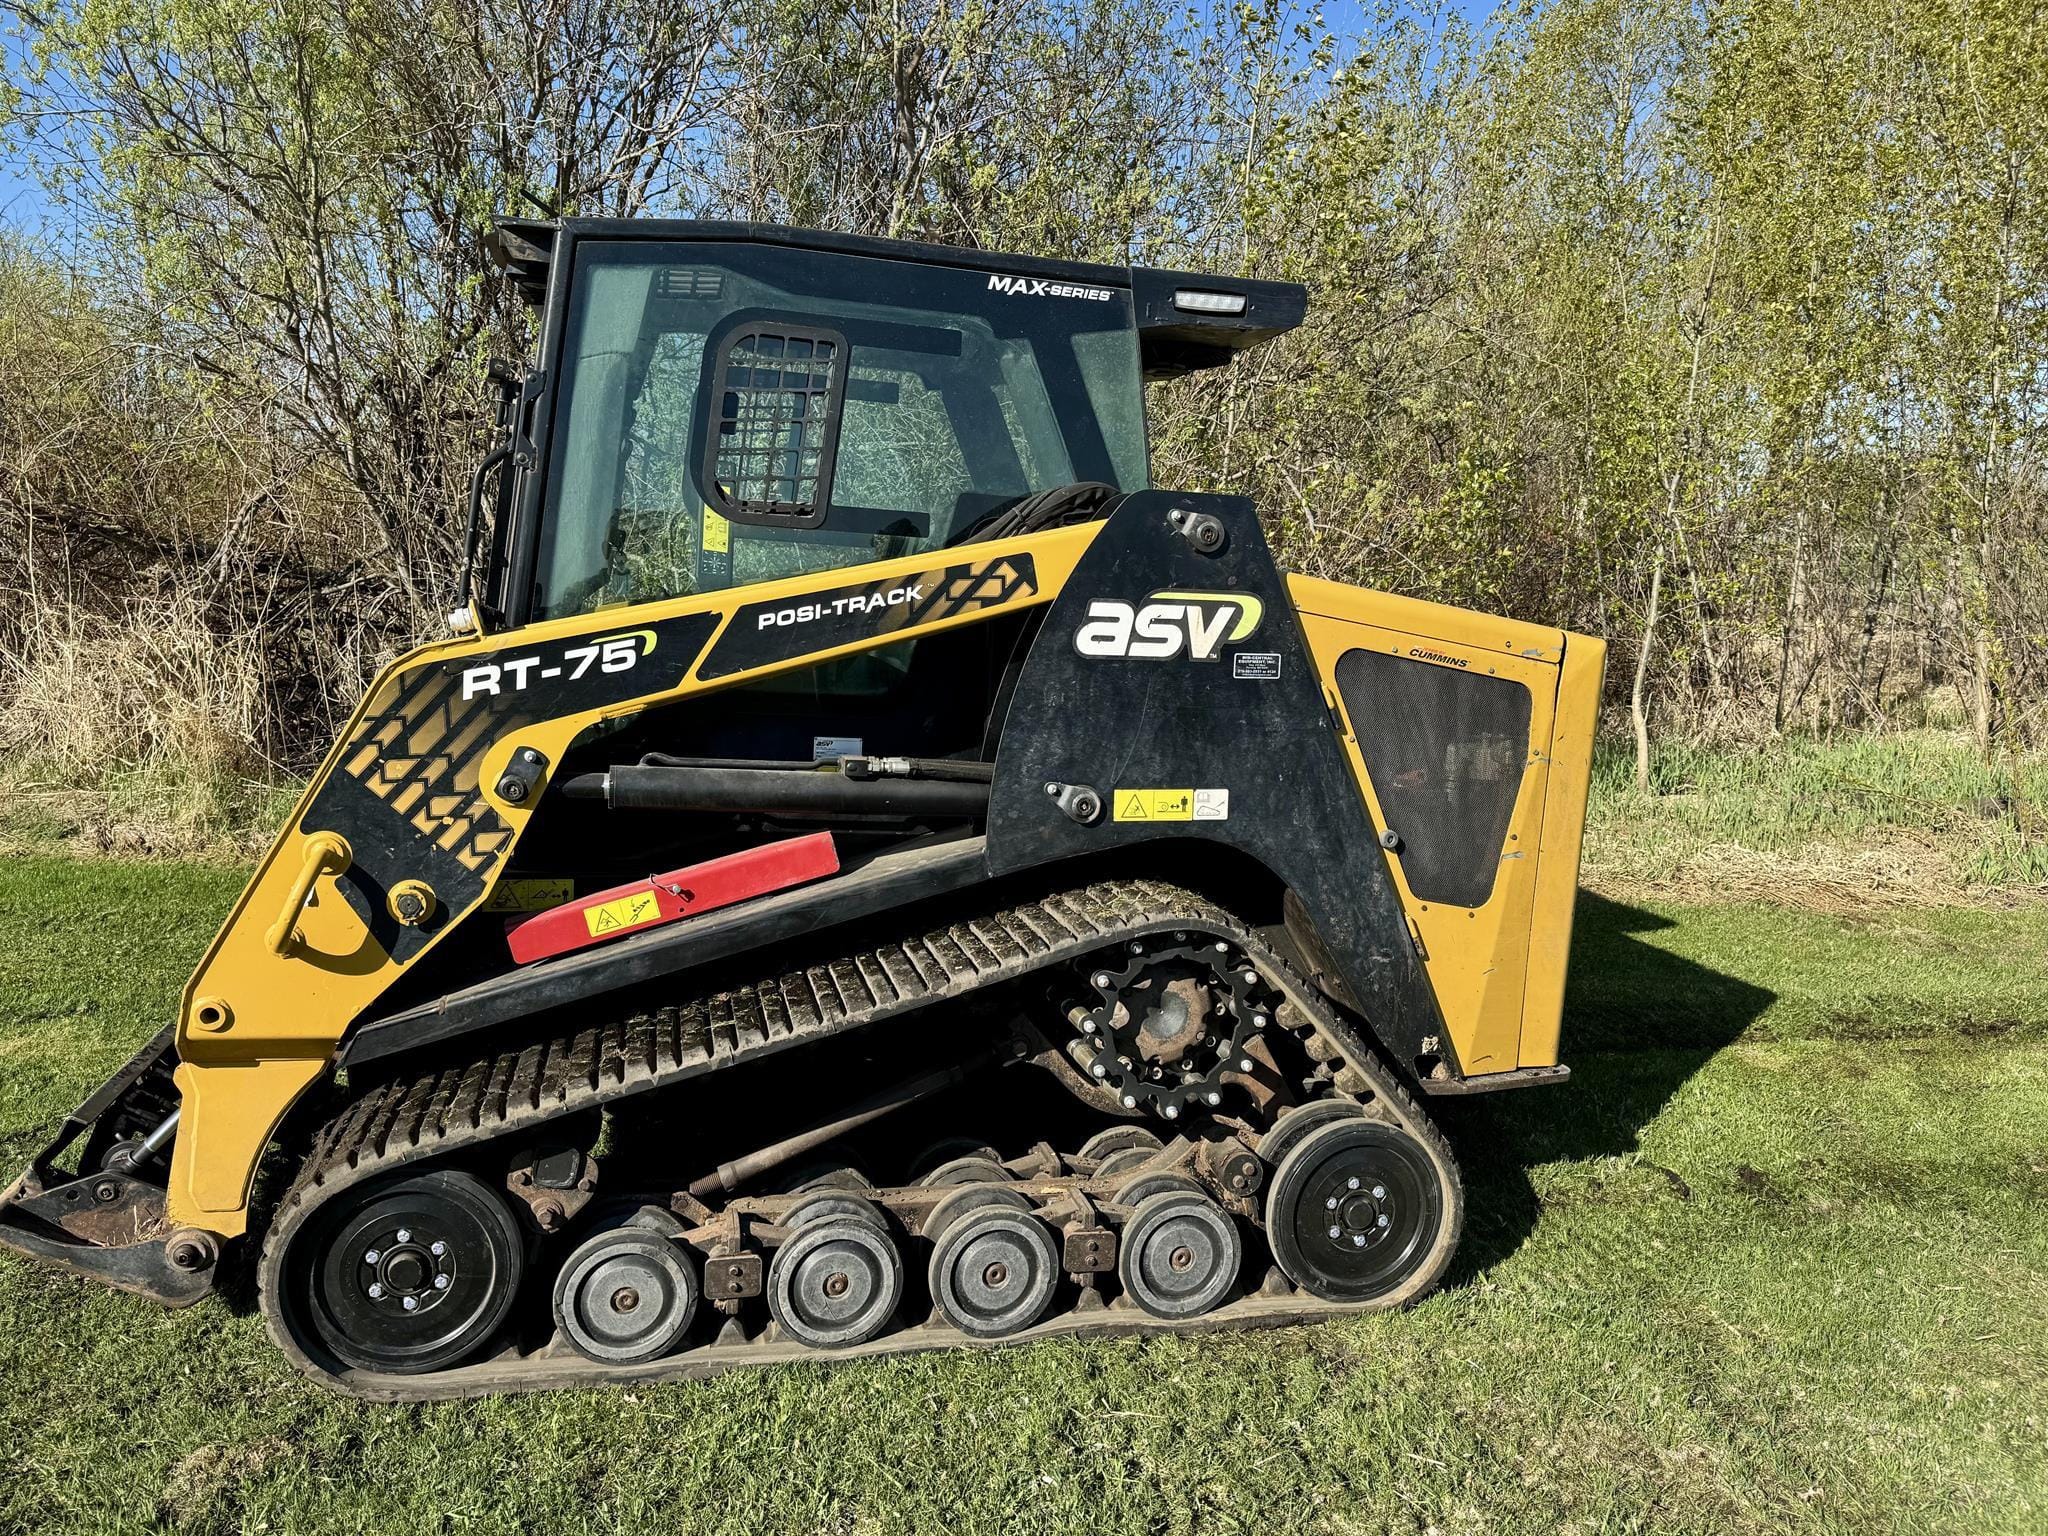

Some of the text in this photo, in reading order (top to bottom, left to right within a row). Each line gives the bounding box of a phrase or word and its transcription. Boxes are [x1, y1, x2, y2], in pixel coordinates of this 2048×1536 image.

[987, 275, 1111, 301] MAX-SERIES
[758, 584, 923, 631] POSI-TRACK
[462, 638, 637, 701] RT-75
[1409, 648, 1468, 667] CUMMINS
